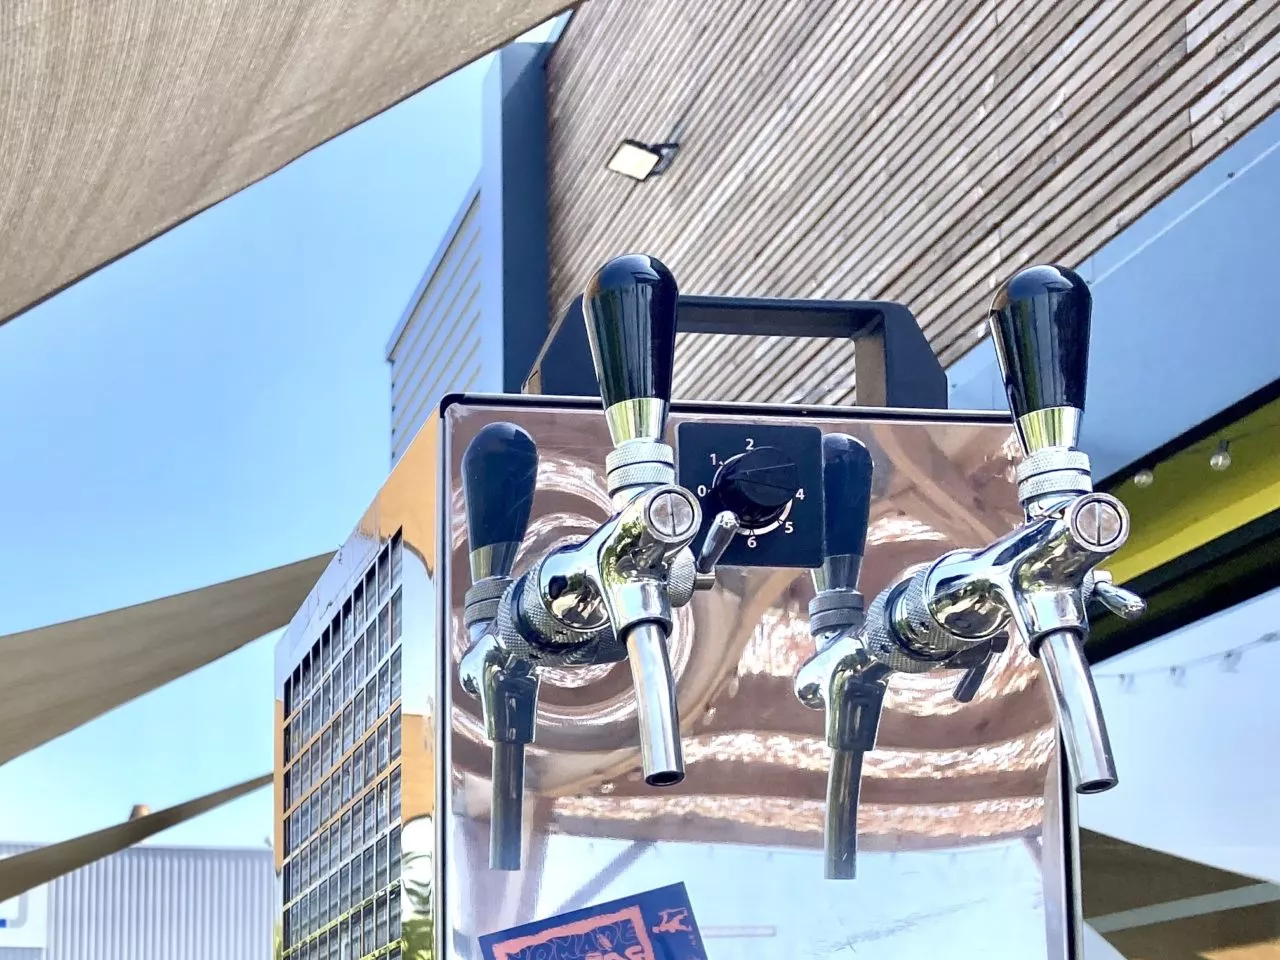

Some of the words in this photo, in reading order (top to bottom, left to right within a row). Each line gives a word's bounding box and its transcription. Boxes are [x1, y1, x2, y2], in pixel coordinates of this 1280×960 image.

[745, 438, 755, 450] 2
[709, 453, 717, 466] 1
[697, 484, 707, 497] 0
[795, 488, 805, 500] 4
[784, 521, 794, 534] 5
[747, 536, 757, 548] 6
